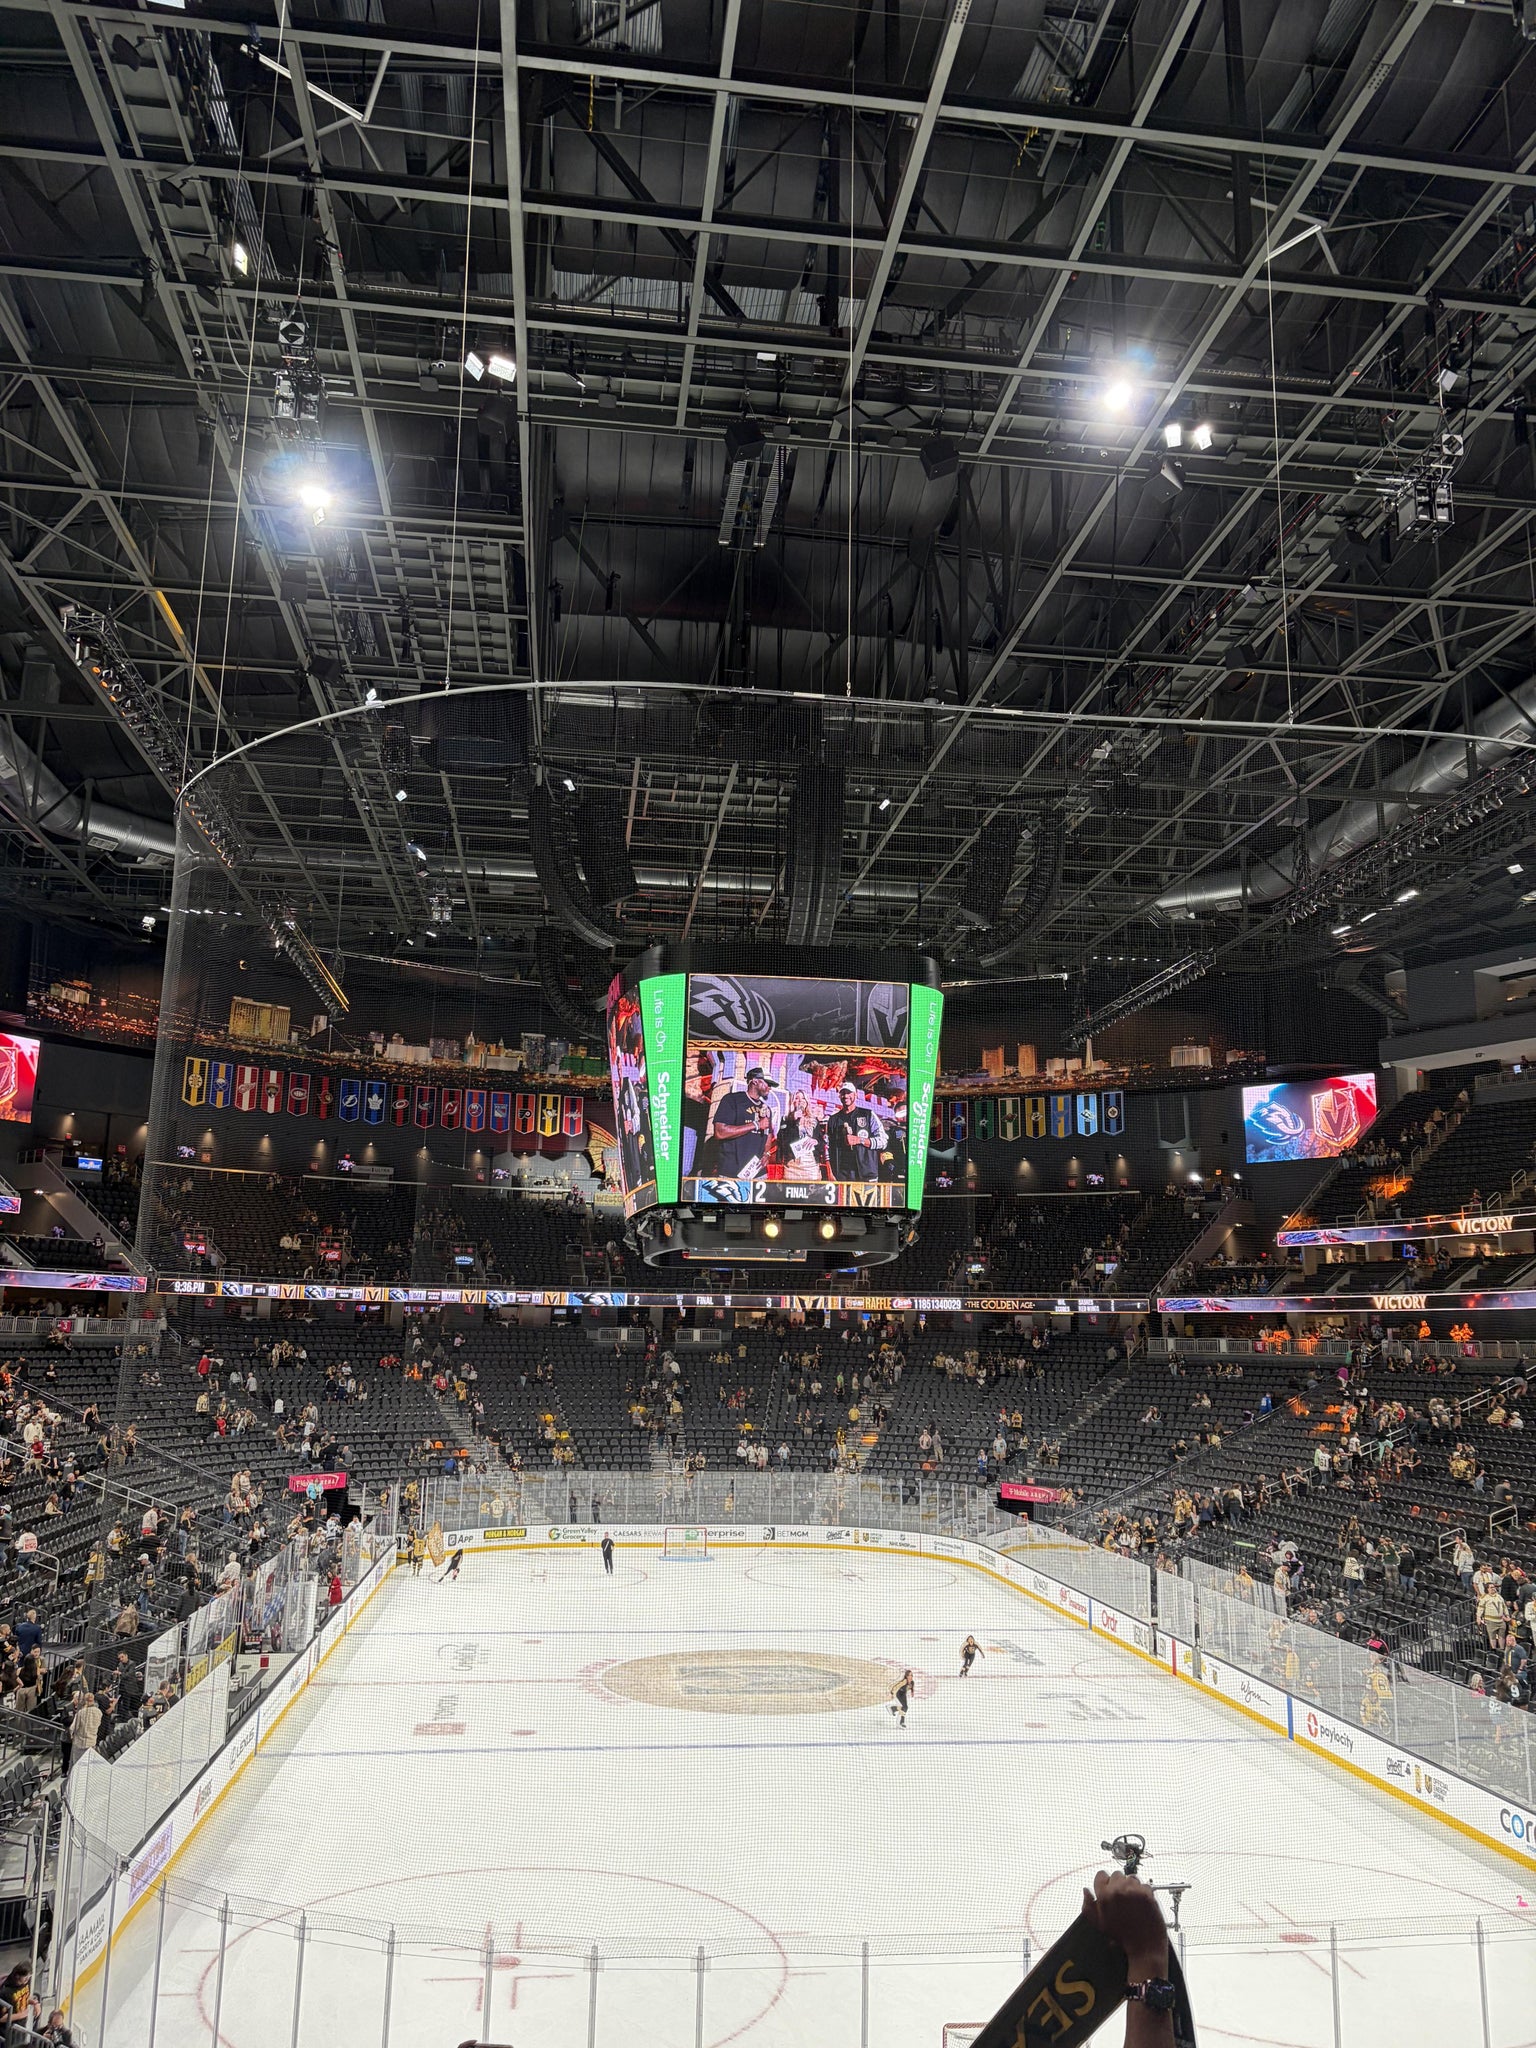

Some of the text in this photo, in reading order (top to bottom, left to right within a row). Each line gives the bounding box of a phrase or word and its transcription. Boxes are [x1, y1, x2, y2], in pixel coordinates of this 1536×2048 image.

[654, 990, 664, 1014] Life
[928, 1002, 937, 1024] Life
[658, 1072, 672, 1161] Schneider
[916, 1082, 930, 1169] Schneider
[909, 1118, 921, 1165] Electric
[756, 1182, 836, 1204] 2 FINAL 3
[1457, 1216, 1514, 1234] VICTORY
[174, 1282, 205, 1293] 9:36 PM
[634, 1296, 640, 1305] 2
[696, 1296, 714, 1305] FINAL
[766, 1298, 772, 1307] 3
[865, 1298, 892, 1309] RAFFLE
[981, 1300, 1019, 1310] GOLDEN
[1372, 1296, 1427, 1310] VICTORY
[63, 1321, 68, 1330] 3
[1240, 1681, 1271, 1705] Wynn
[1511, 1685, 1520, 1698] 9
[1320, 1724, 1354, 1753] paylocity
[1500, 1808, 1536, 1844] cor
